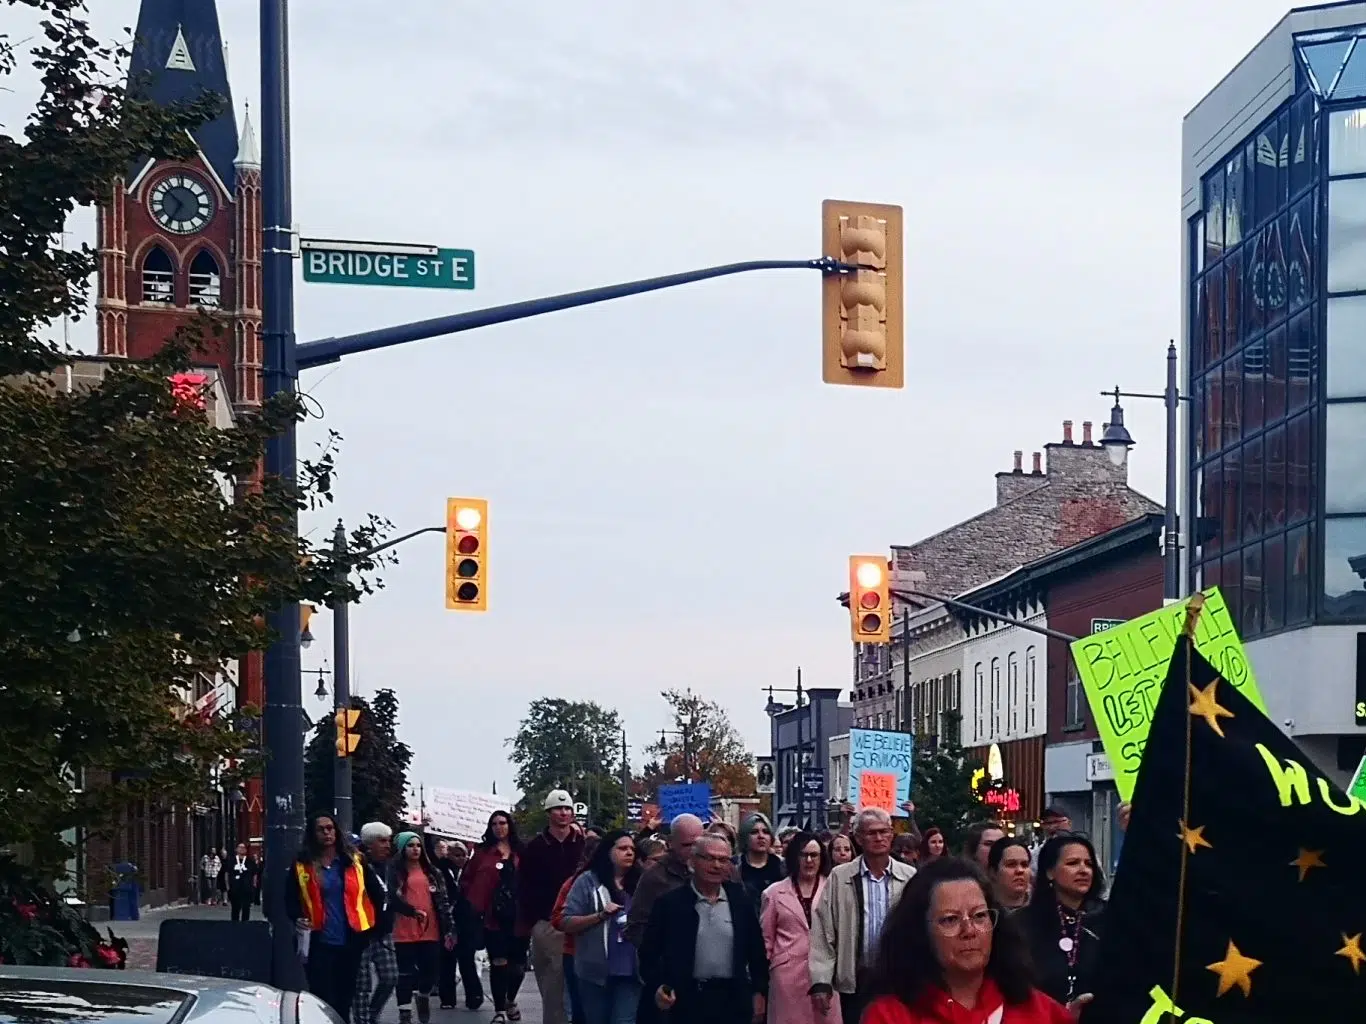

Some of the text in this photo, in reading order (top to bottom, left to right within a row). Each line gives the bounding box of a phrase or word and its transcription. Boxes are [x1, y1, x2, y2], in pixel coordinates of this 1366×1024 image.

[310, 252, 468, 281] BRIDGE ST E
[1102, 674, 1167, 737] LET'
[853, 732, 872, 749] WE
[853, 751, 911, 772] SURVIVORS
[576, 804, 584, 813] P
